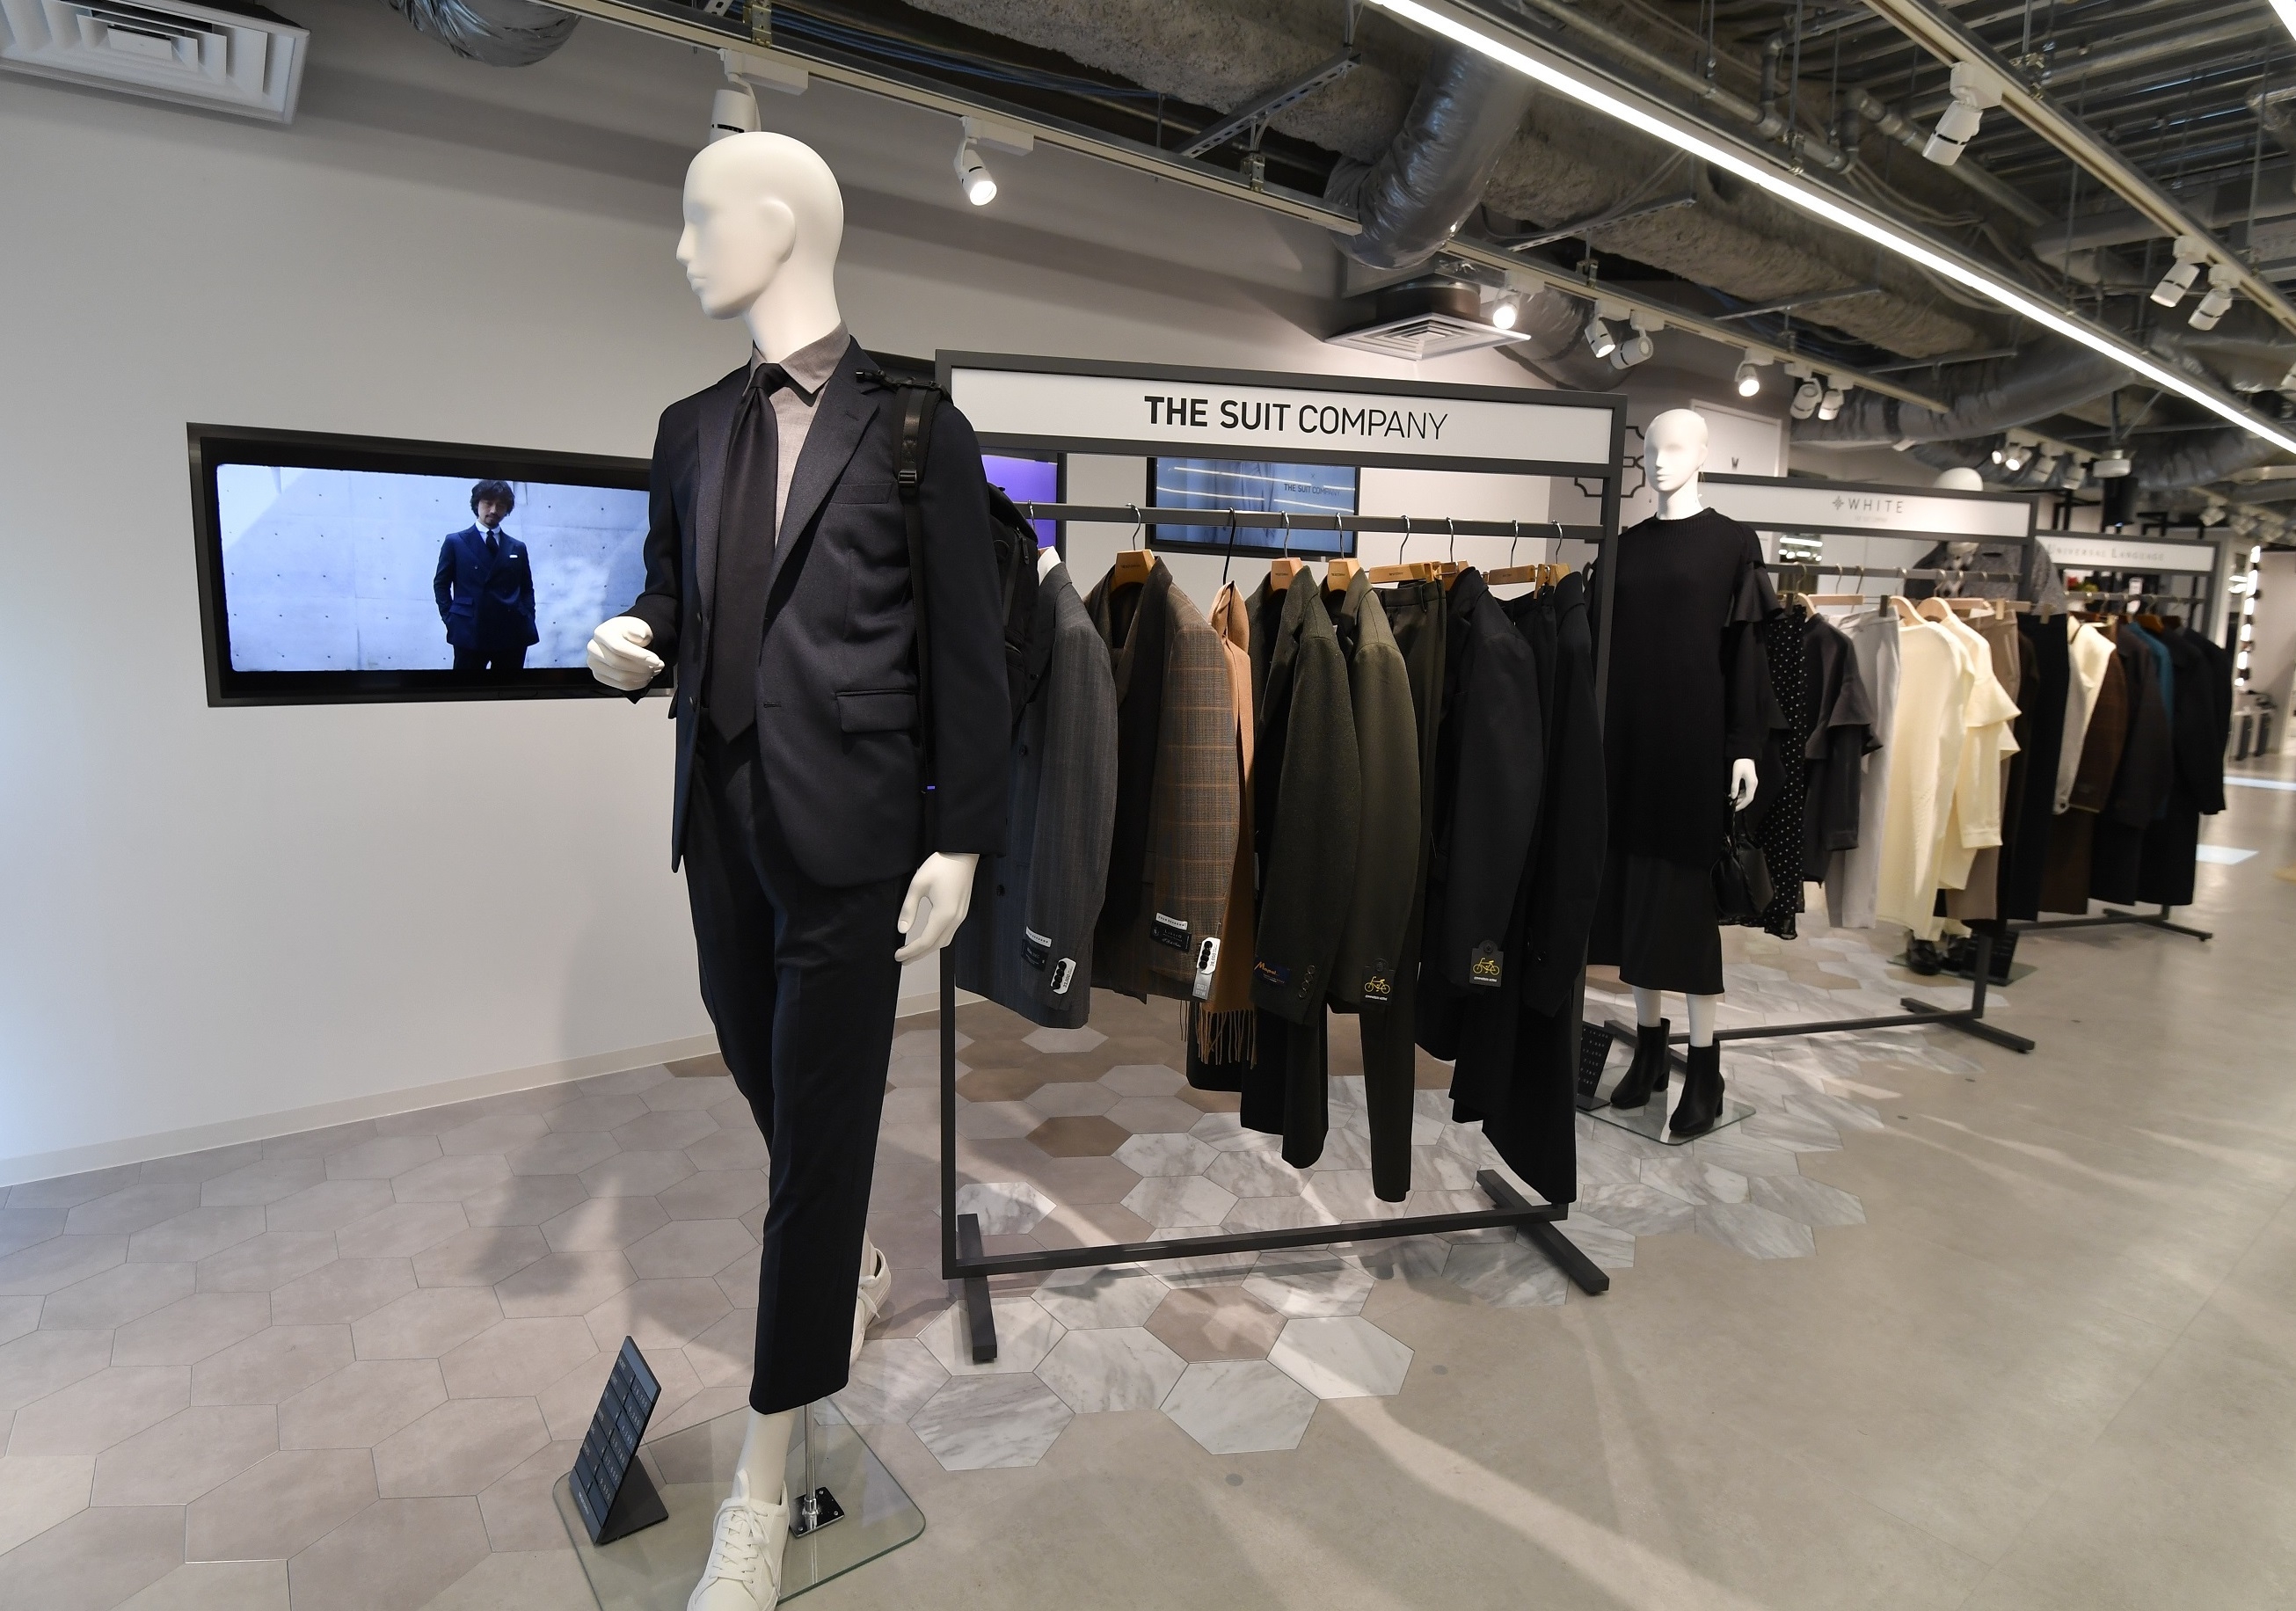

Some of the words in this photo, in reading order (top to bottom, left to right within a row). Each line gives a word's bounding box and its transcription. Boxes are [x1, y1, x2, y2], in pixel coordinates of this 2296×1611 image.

[1144, 396, 1208, 427] THE
[1221, 399, 1291, 431] SUIT
[1299, 405, 1448, 440] COMPANY
[1284, 483, 1296, 492] THE
[1297, 485, 1311, 493] SUIT
[1848, 498, 1903, 514] WHITE
